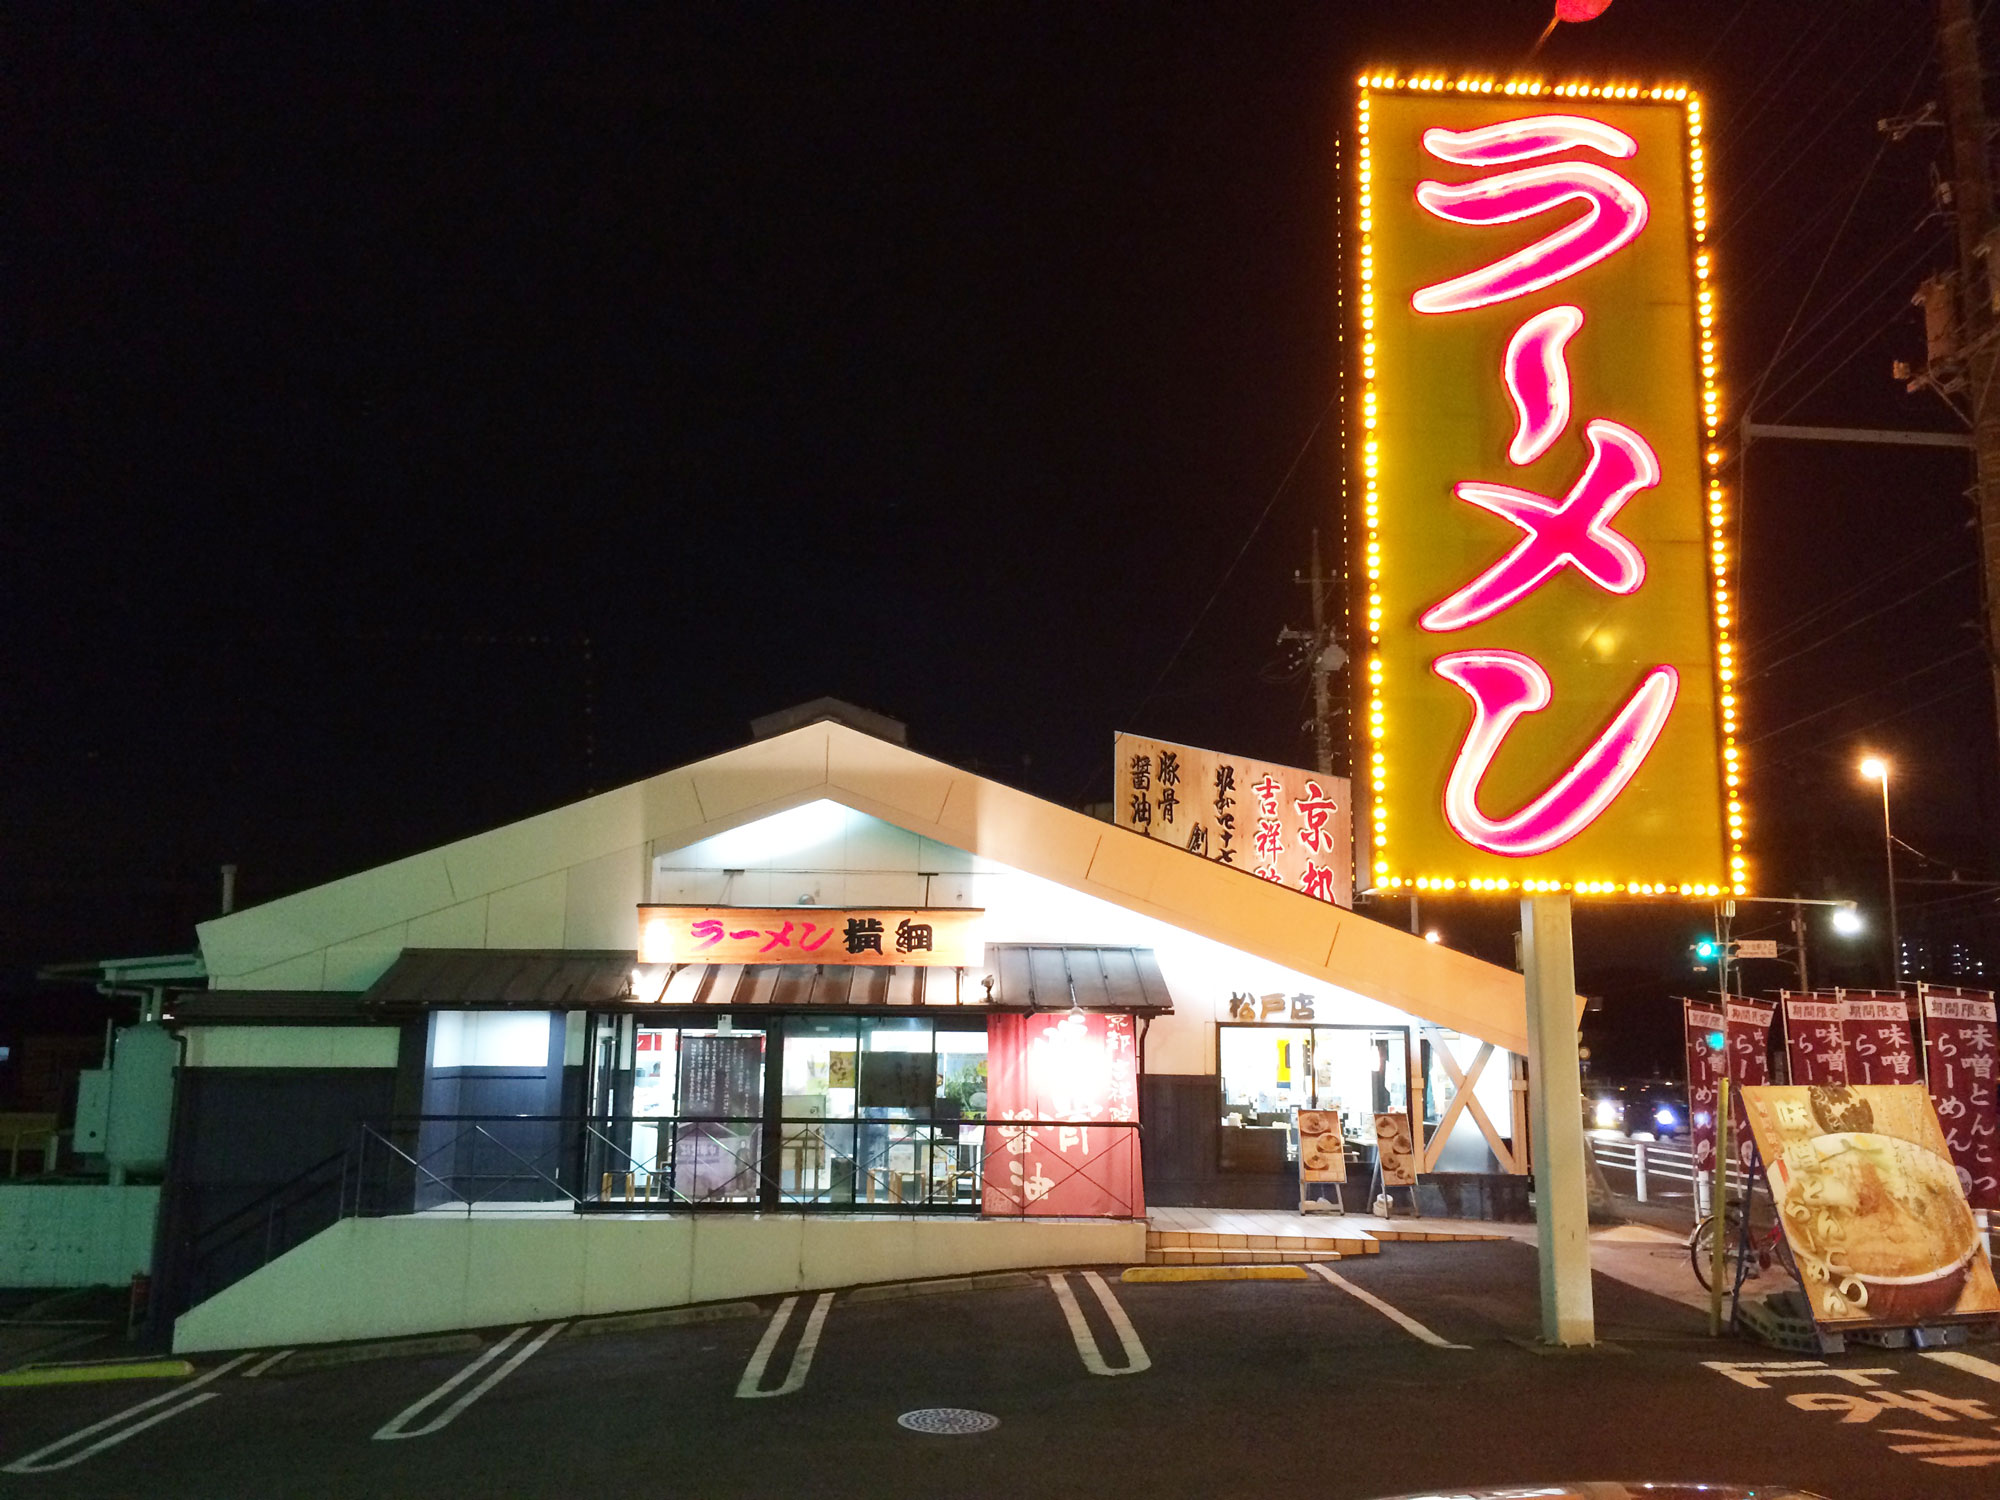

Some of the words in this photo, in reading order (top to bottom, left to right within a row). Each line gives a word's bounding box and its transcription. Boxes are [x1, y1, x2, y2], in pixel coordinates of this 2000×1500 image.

[1411, 114, 1680, 857] ラーメン
[1130, 754, 1152, 836] 醤油
[1229, 991, 1315, 1020] 松戸店
[1792, 1005, 1839, 1020] 期間限定
[1849, 1005, 1903, 1019] 期間限定
[1932, 999, 1992, 1019] 期間限定
[1938, 1033, 1972, 1152] らーめん
[1958, 1024, 1998, 1191] 味噌とんこつ
